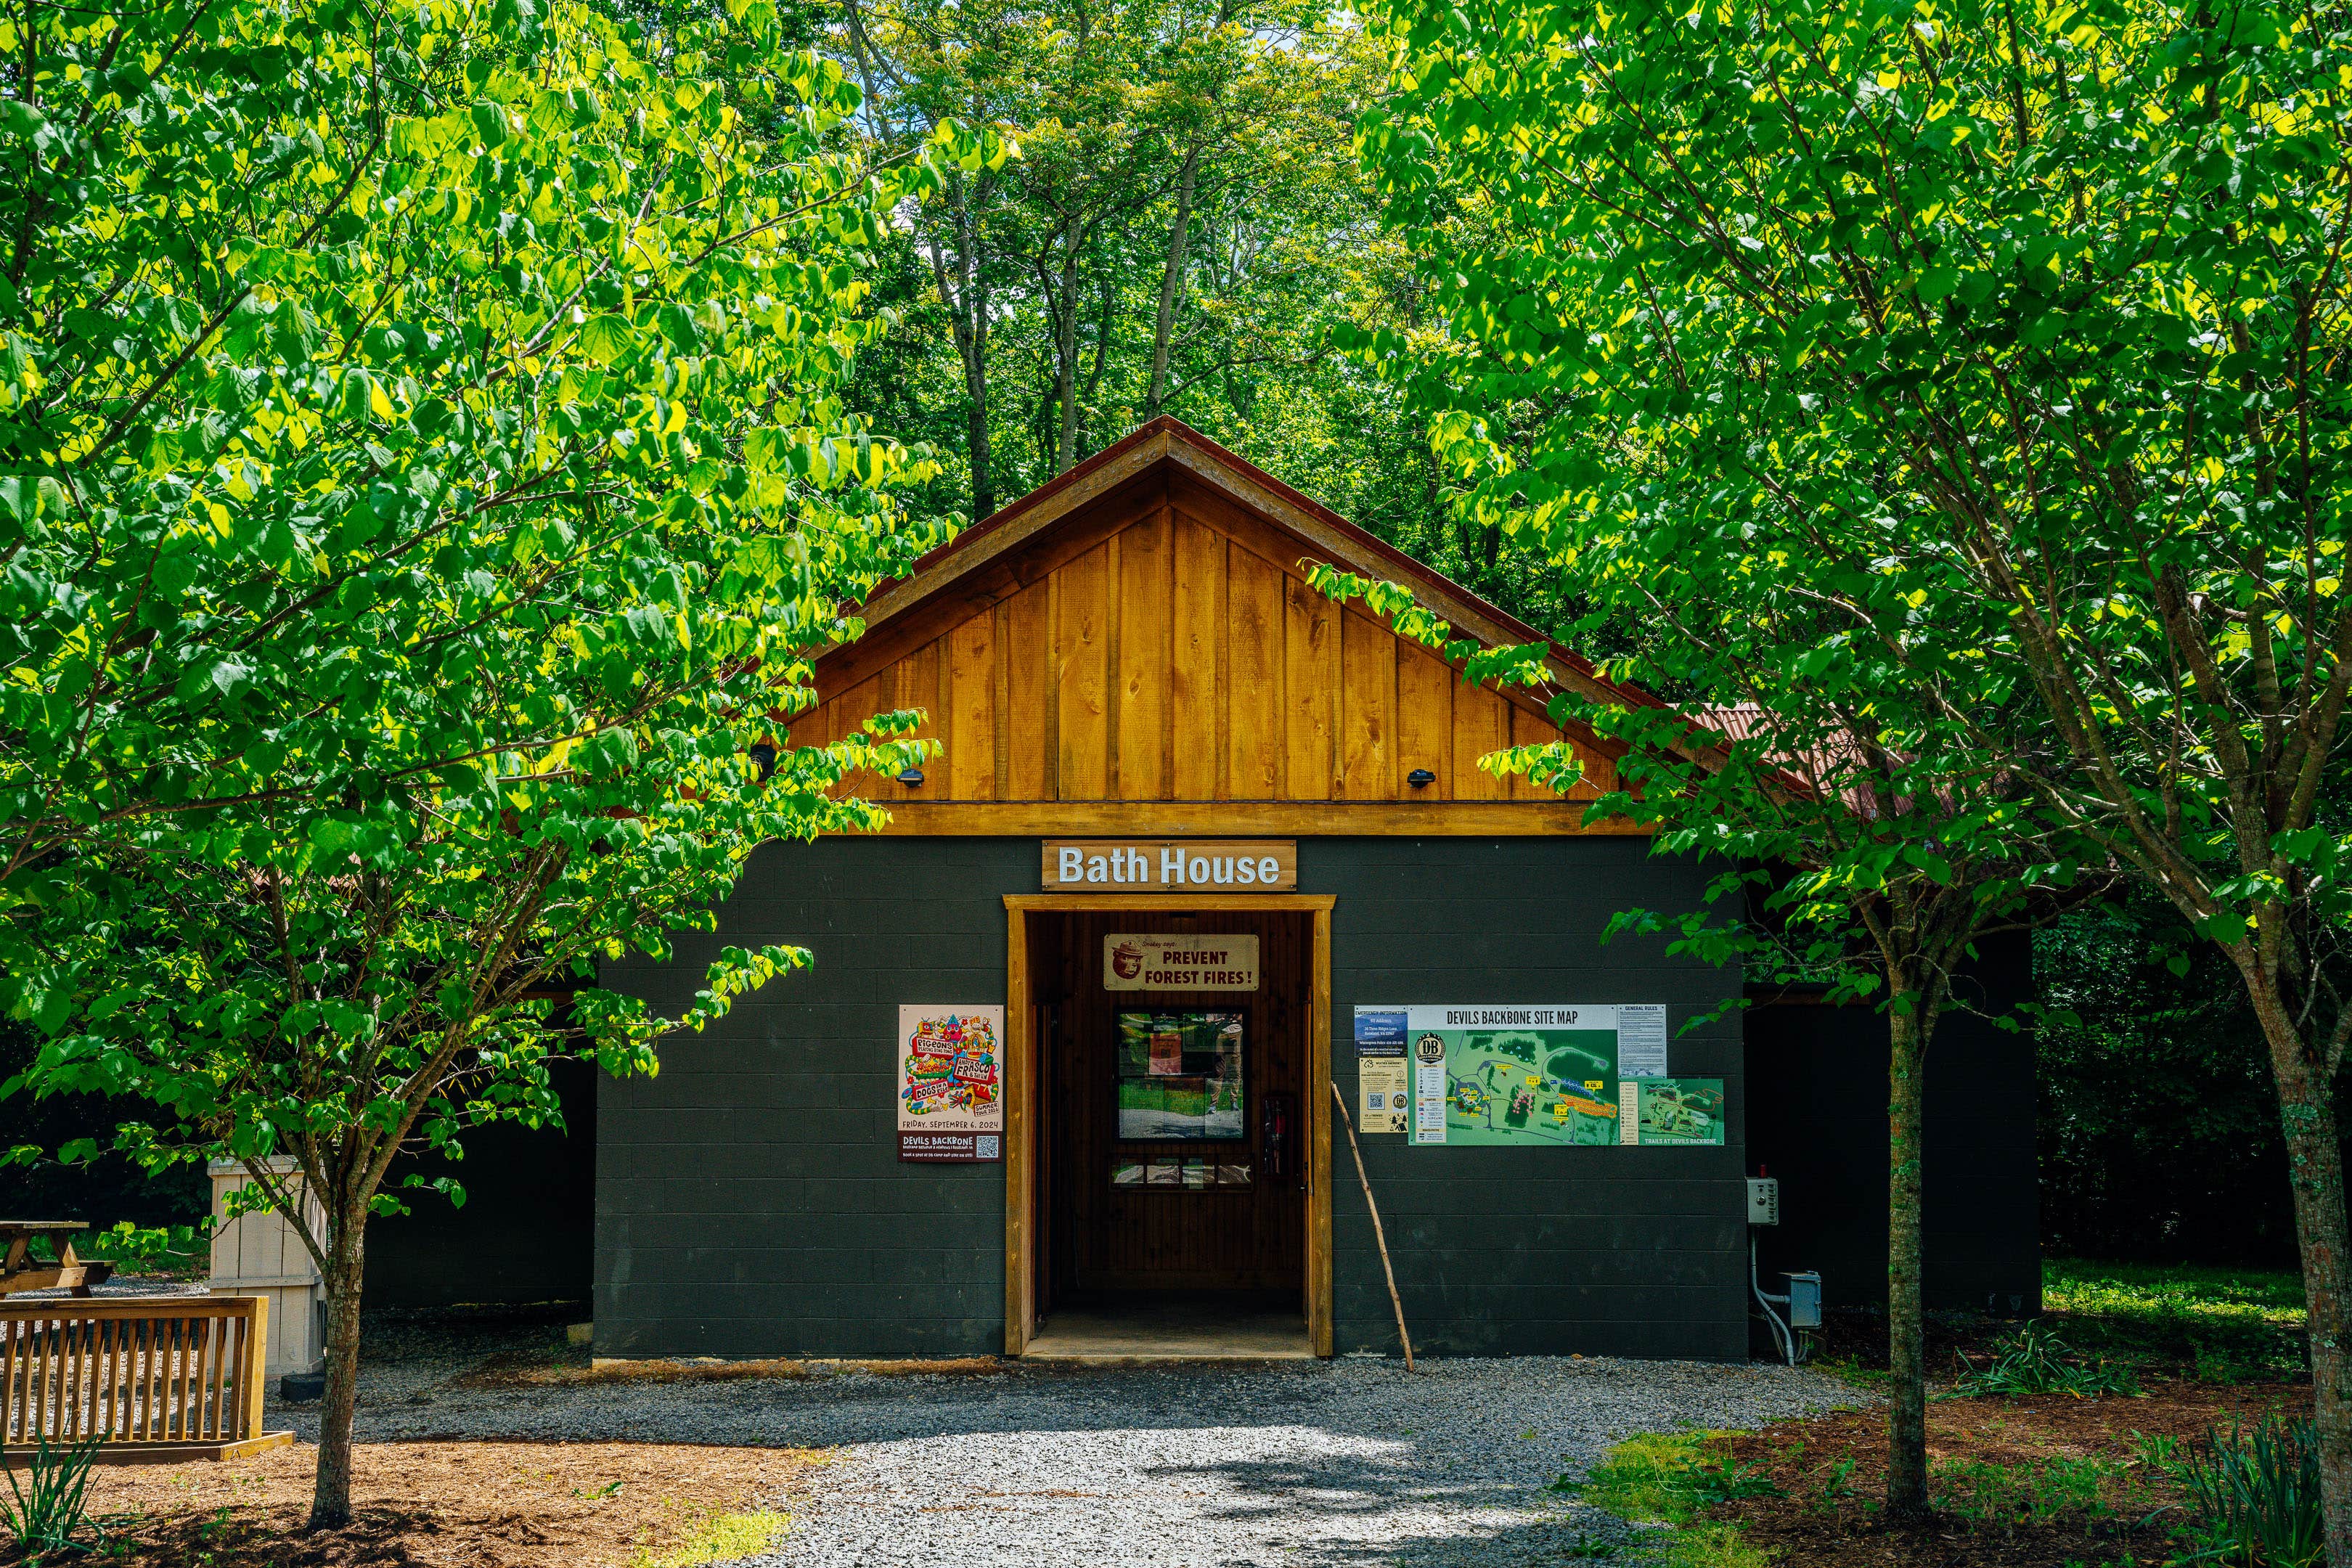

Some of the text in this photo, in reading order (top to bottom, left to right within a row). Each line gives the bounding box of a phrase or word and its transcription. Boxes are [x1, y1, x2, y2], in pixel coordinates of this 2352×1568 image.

[1059, 847, 1280, 884] Bath House
[1163, 951, 1228, 965] PREVENT
[1145, 971, 1251, 984] FOREST FIRES!
[1447, 1010, 1578, 1024] DEVILS BACKBONE SITE MAP
[1423, 1040, 1438, 1054] DB
[957, 1061, 989, 1076] FRASCO
[917, 1085, 936, 1098] DOGS
[976, 1102, 998, 1111] SUMMER
[902, 1119, 928, 1128] FRIDAY,
[903, 1136, 973, 1146] DEVILS BACKBONE
